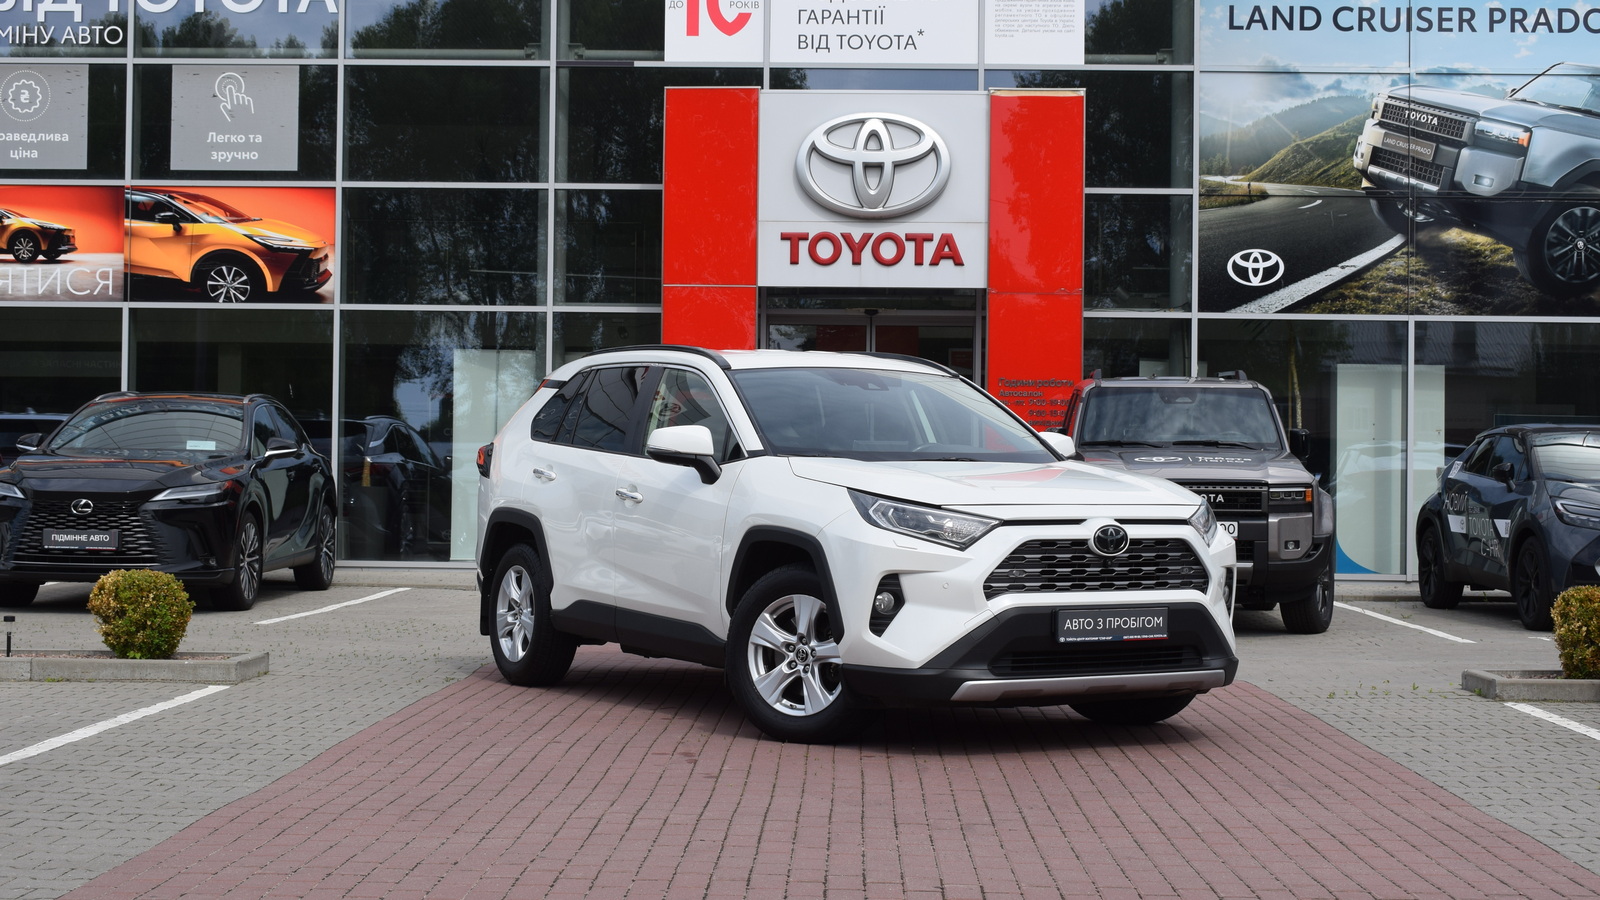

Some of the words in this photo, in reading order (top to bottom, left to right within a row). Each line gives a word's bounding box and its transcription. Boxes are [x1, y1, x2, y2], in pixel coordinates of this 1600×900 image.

[669, 1, 684, 10] ДО
[729, 0, 760, 9] РОКІВ
[798, 5, 886, 25] ГАРАНТІЇ
[1228, 5, 1322, 31] LAND
[1332, 6, 1478, 33] CRUISER
[1488, 7, 1600, 34] PRADO
[60, 25, 124, 45] АВТО
[797, 34, 831, 53] ВІД
[1405, 110, 1438, 126] TOYOTA
[206, 131, 246, 143] Легко
[248, 134, 263, 143] та
[10, 147, 39, 160] ціна
[211, 151, 259, 162] зручно
[780, 231, 965, 267] TOYOTA
[999, 378, 1035, 388] Години
[1037, 378, 1074, 388] роботи
[999, 389, 1043, 397] Автосалон
[1028, 419, 1065, 427] вихідни
[1468, 517, 1495, 537] TOYOTA
[51, 534, 88, 542] ПІДМІННЕ
[89, 534, 110, 542] АВТО
[1064, 618, 1094, 630] АВТО
[1106, 616, 1163, 629] ПРОБІГОМ
